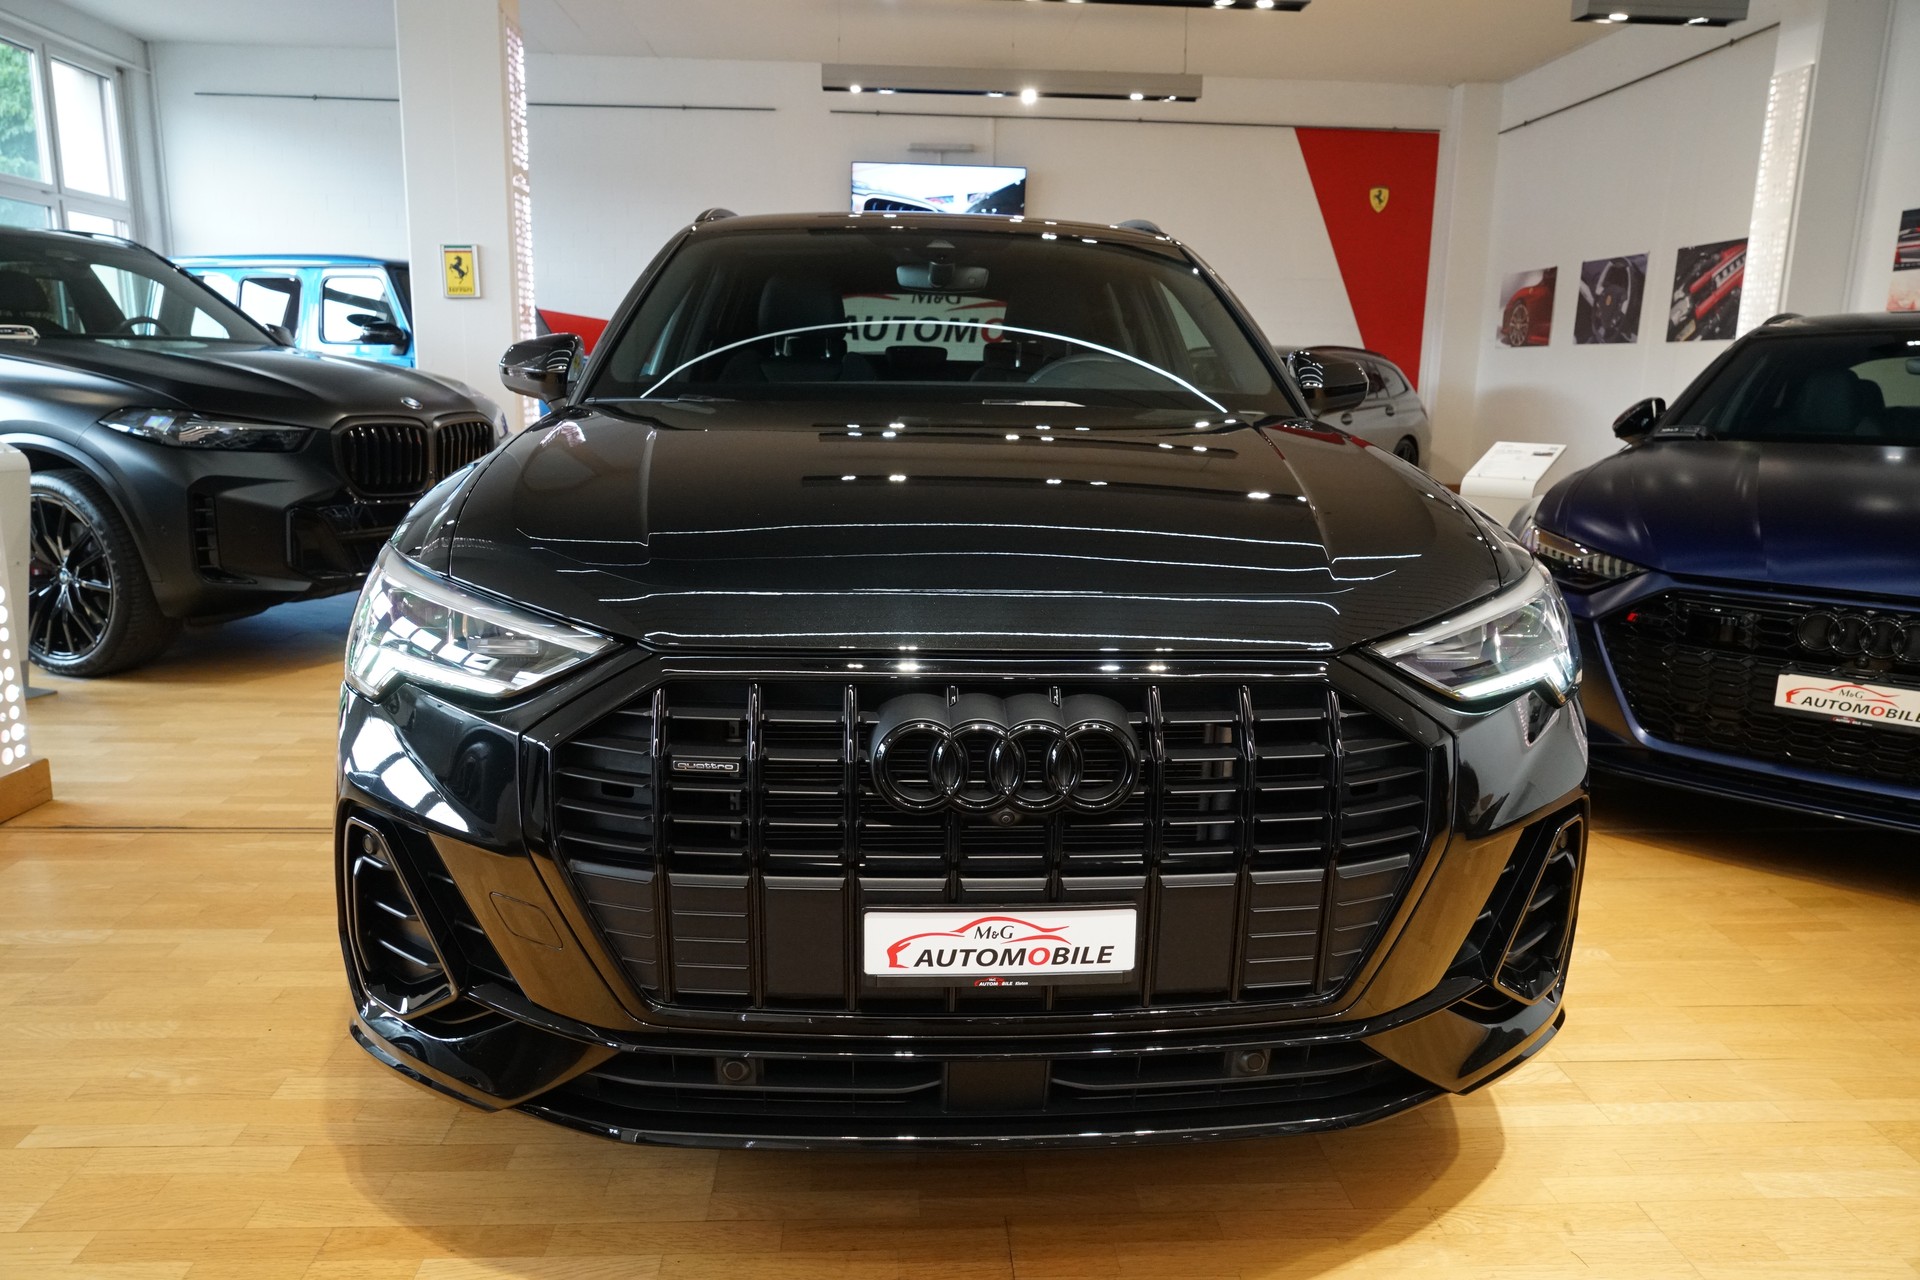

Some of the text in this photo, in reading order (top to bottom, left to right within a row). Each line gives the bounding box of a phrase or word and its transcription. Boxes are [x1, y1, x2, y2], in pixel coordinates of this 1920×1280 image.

[1838, 688, 1865, 700] M&G
[677, 762, 734, 770] quattro
[973, 925, 1015, 940] M&G
[913, 945, 1115, 968] AUTOMOBILE
